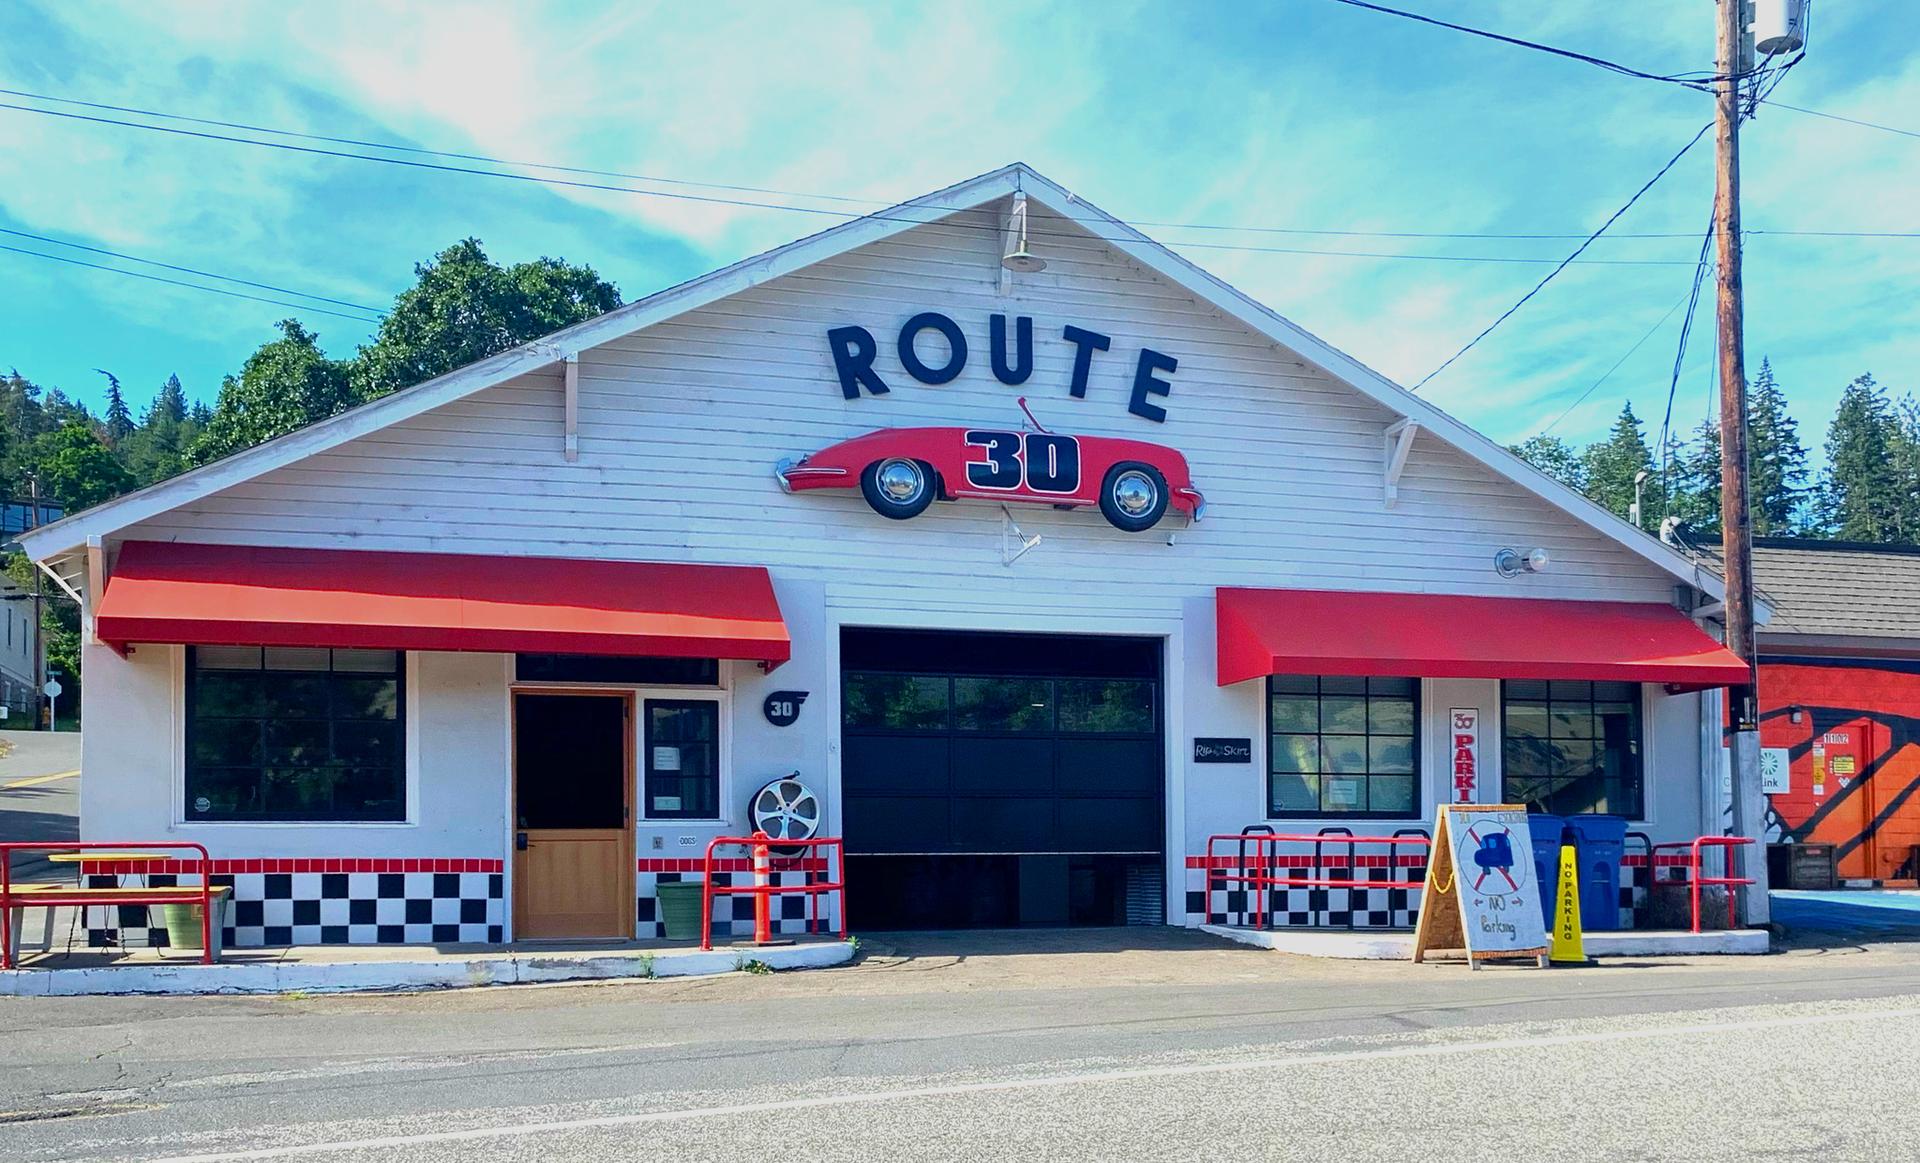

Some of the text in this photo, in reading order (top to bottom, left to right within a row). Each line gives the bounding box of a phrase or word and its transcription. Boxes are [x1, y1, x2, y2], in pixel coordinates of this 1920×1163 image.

[828, 311, 1177, 423] ROUTE
[964, 430, 1082, 494] 30
[770, 701, 793, 717] 30
[1489, 895, 1506, 911] NO
[1563, 863, 1573, 940] NO PARKING
[1481, 913, 1517, 941] Parking
